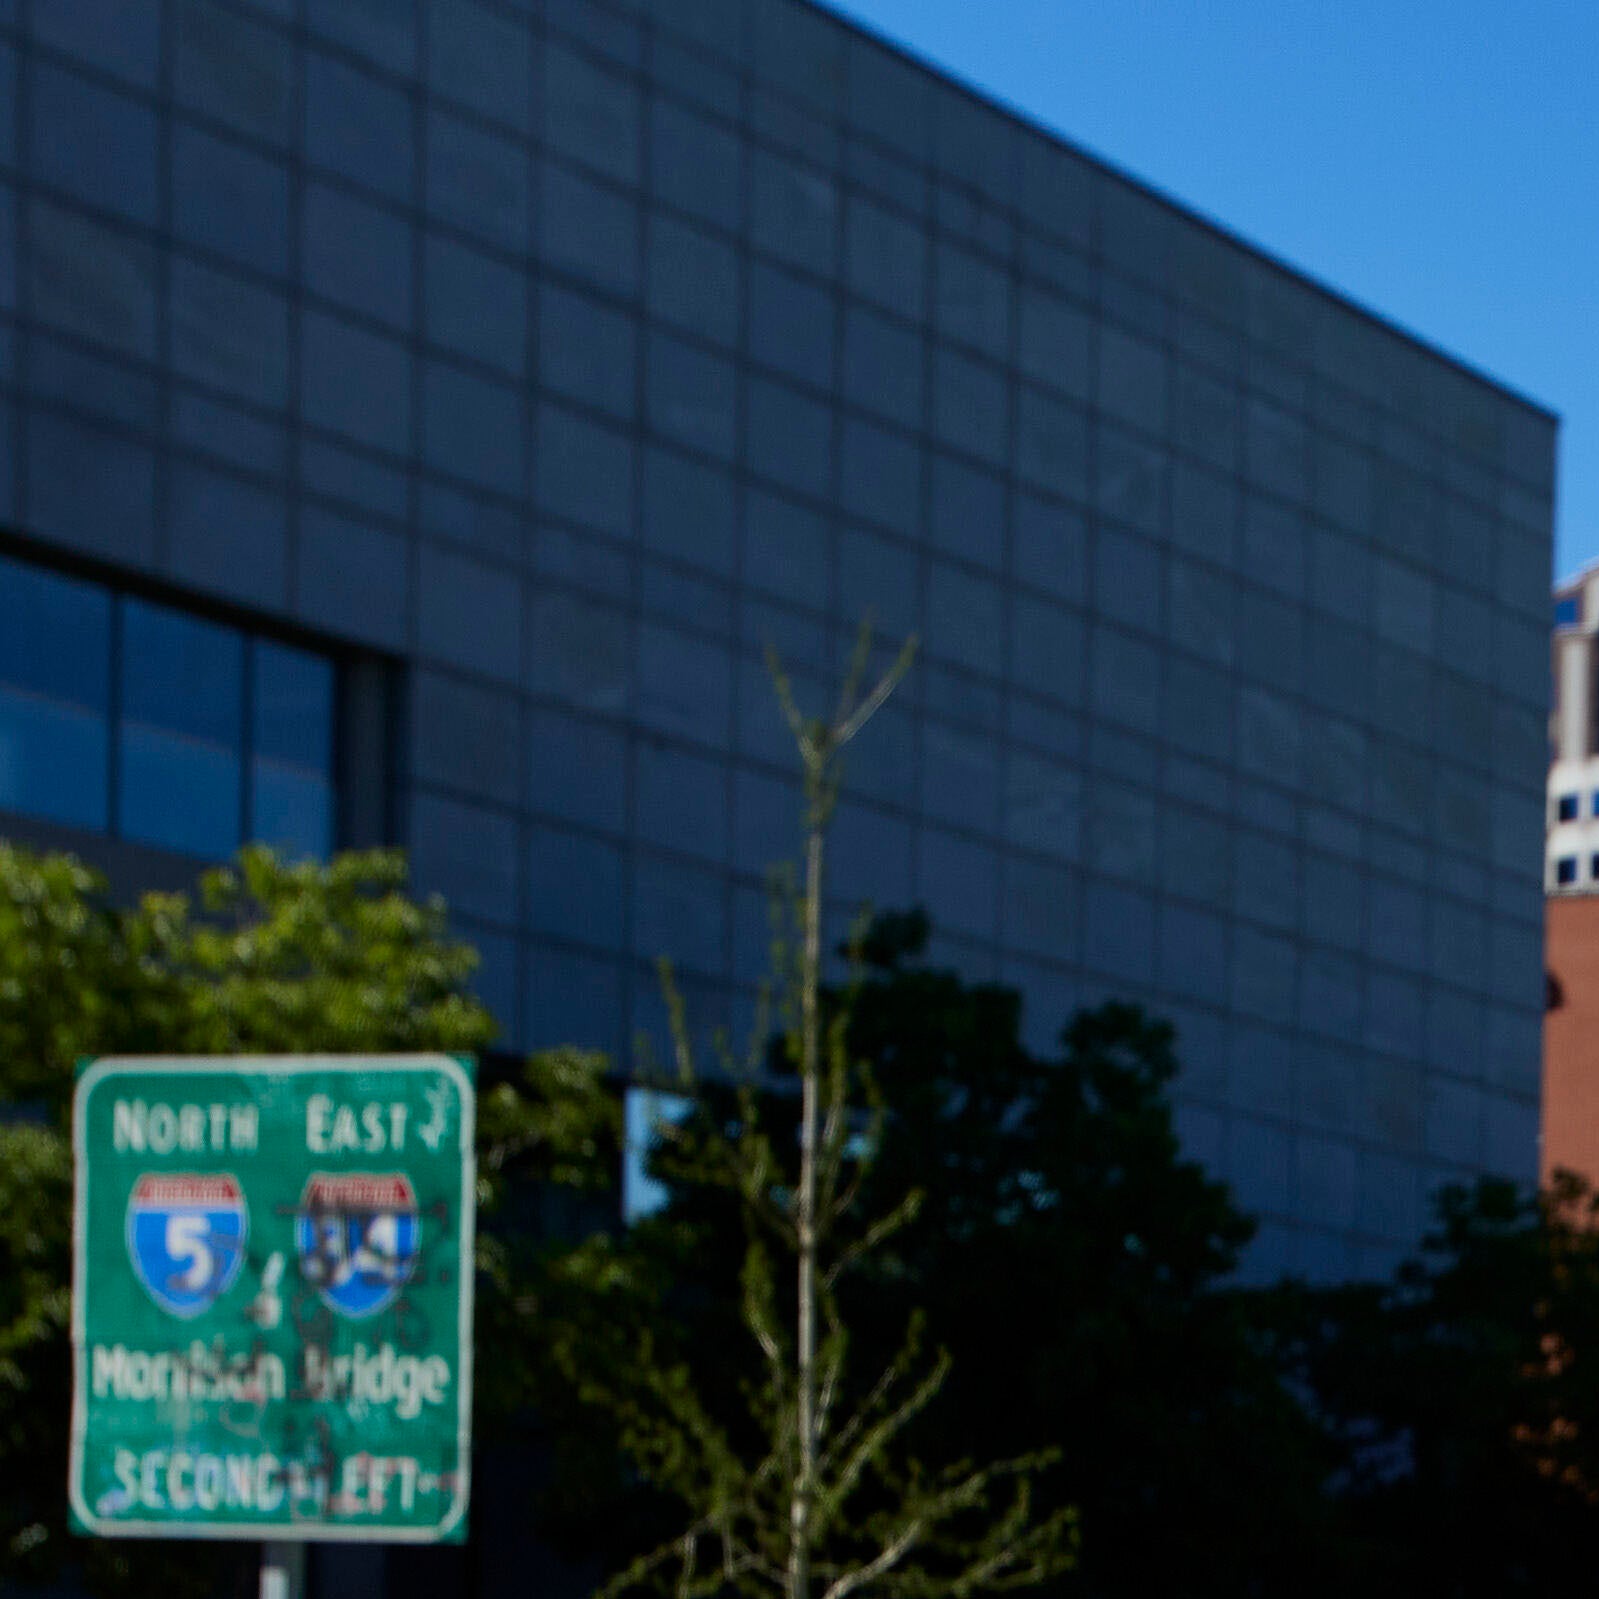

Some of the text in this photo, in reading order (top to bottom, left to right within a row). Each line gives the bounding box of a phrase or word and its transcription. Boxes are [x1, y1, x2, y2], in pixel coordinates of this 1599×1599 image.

[113, 1093, 408, 1155] NORTH EAST
[166, 1215, 213, 1291] 5
